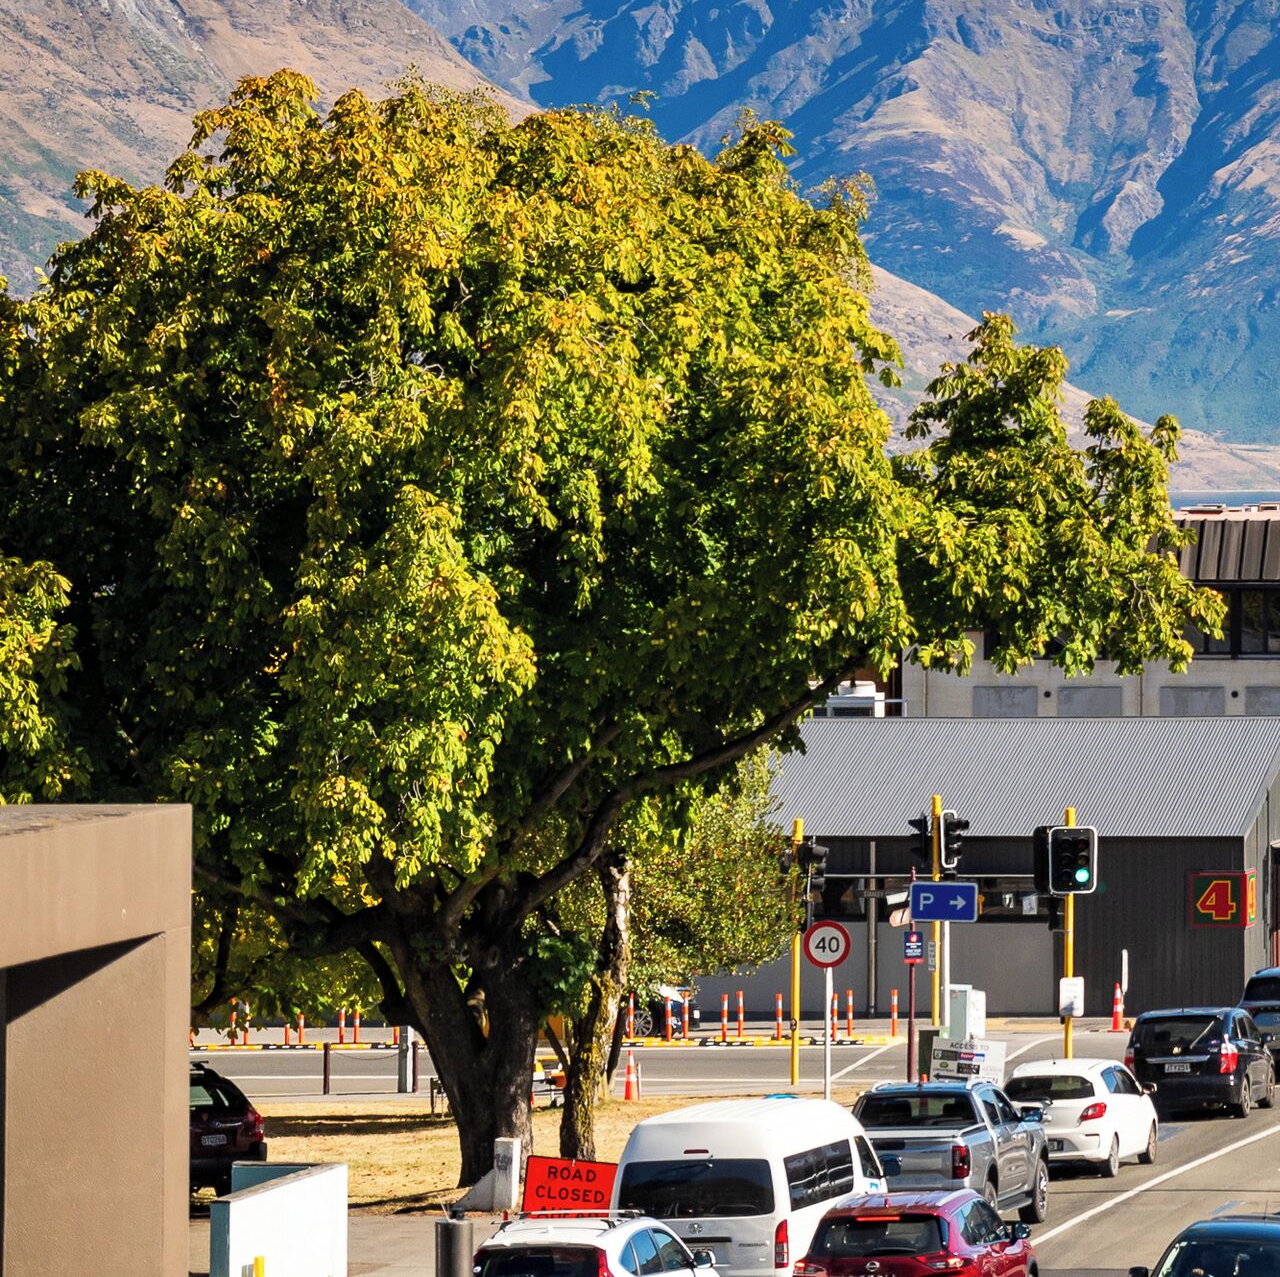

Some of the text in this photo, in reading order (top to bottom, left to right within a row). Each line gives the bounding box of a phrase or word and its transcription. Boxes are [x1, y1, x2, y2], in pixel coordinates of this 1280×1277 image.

[919, 892, 935, 911] P
[1196, 880, 1236, 920] 4
[814, 936, 840, 953] 40
[547, 1166, 597, 1182] ROAD
[535, 1185, 605, 1203] CLOSED
